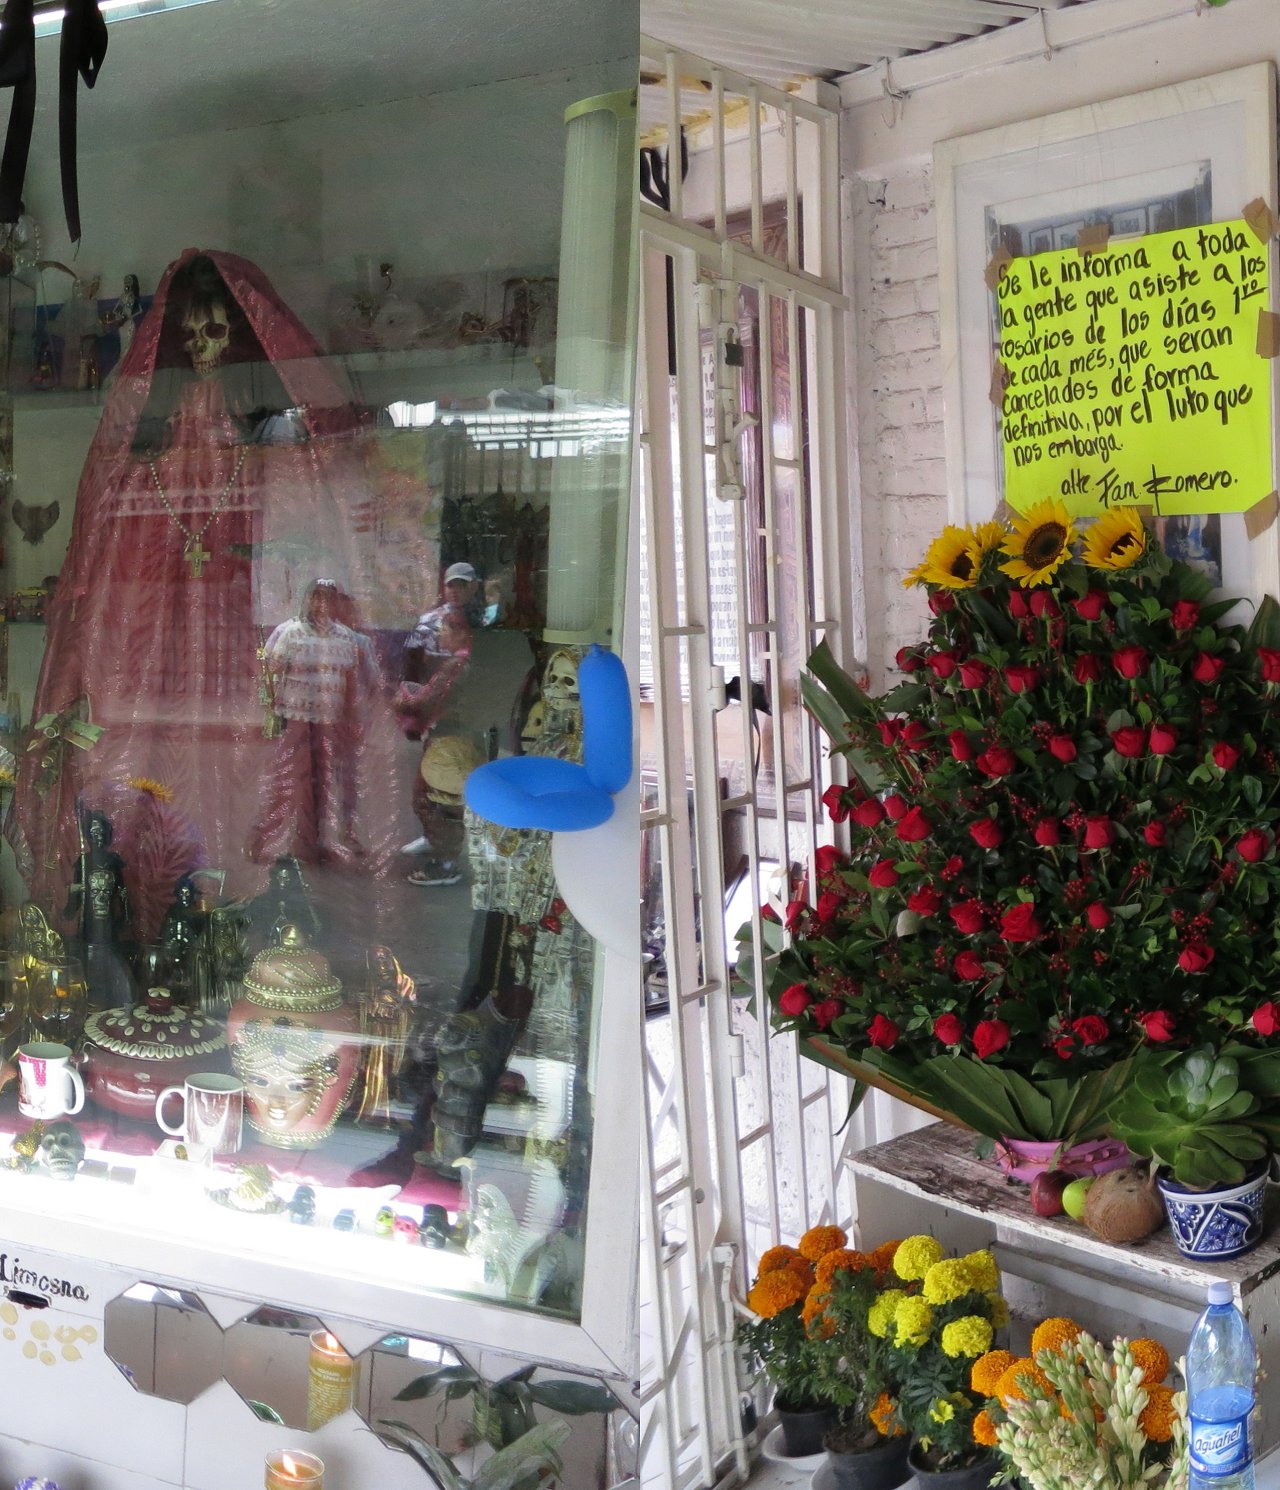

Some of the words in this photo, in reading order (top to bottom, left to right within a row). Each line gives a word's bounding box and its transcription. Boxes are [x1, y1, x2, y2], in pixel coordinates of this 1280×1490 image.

[998, 263, 1022, 299] Se
[1029, 260, 1052, 290] le
[1061, 248, 1152, 283] informa
[1172, 240, 1190, 261] a
[1197, 226, 1250, 260] toda
[1000, 308, 1019, 330] la
[1024, 286, 1078, 339] gente
[1086, 286, 1118, 322] que
[1129, 264, 1201, 300] asiste
[1214, 262, 1234, 284] a
[1240, 254, 1266, 279] los
[1000, 328, 1074, 361] rosarios
[1085, 316, 1106, 344] de
[1121, 308, 1150, 339] los
[1162, 297, 1216, 328] días
[1021, 360, 1063, 388] cada
[1120, 339, 1152, 372] que
[1164, 325, 1233, 356] seran
[1002, 376, 1098, 418] cancelados
[1112, 368, 1136, 398] de
[1144, 360, 1220, 392] forma
[1004, 410, 1090, 444] definitiva,
[1092, 403, 1123, 435] por
[1130, 388, 1152, 424] el
[1166, 385, 1210, 422] luto
[1214, 384, 1253, 426] que
[1013, 442, 1042, 467] nos
[1048, 433, 1124, 463] embarga.
[1194, 1425, 1241, 1455] aguafiel
